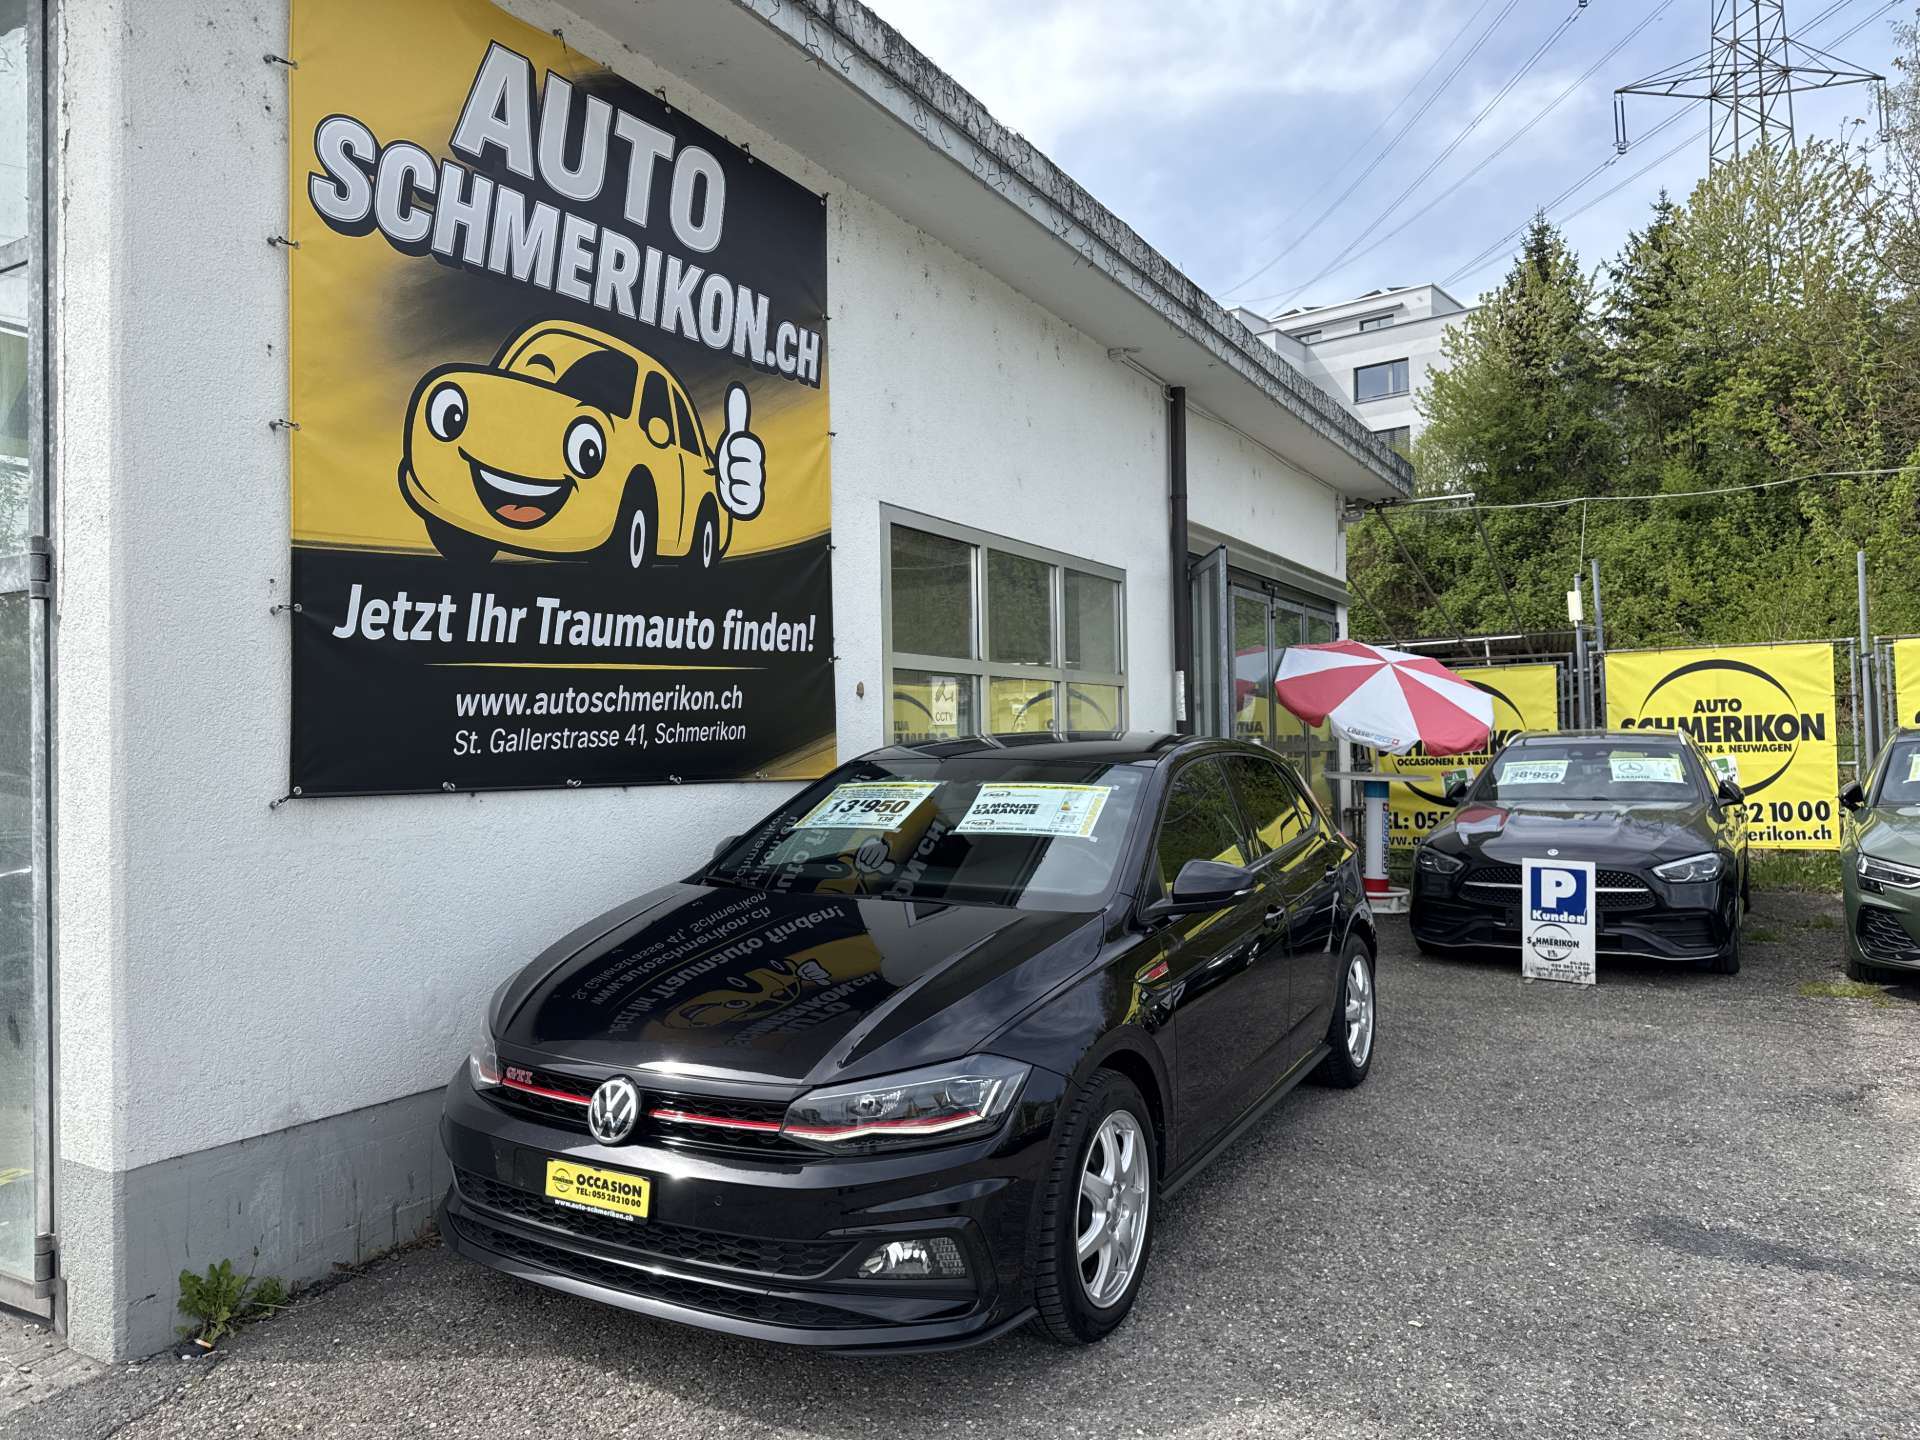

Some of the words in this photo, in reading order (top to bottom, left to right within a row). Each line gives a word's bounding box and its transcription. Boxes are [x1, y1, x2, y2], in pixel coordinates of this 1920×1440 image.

[451, 41, 726, 253] AUTO
[309, 115, 821, 386] SCHMERIKON.CH
[332, 584, 457, 641] Jetzt
[467, 592, 526, 644] Ihr
[536, 597, 714, 650] Traumauto
[723, 609, 816, 652] finden!
[456, 684, 743, 717] www.autoschmerikon.ch
[1693, 698, 1742, 714] AUTO
[935, 713, 954, 722] CCTV
[453, 730, 481, 756] St.
[490, 727, 619, 754] Gallerstrasse
[625, 724, 649, 749] 41,
[655, 722, 746, 744] Schmerikon
[1729, 743, 1792, 753] NEUWAGEN
[1398, 757, 1454, 767] OCCASIONEN
[1457, 757, 1465, 765] &
[829, 800, 910, 813] 13'950
[1541, 869, 1577, 908] P
[1532, 910, 1586, 924] Kunden
[506, 1067, 533, 1085] GTI
[576, 1174, 642, 1197] OCCASION
[576, 1187, 591, 1197] TEL:
[592, 1191, 606, 1199] 055
[555, 1199, 634, 1221] www.auto-schmerikon.ch
